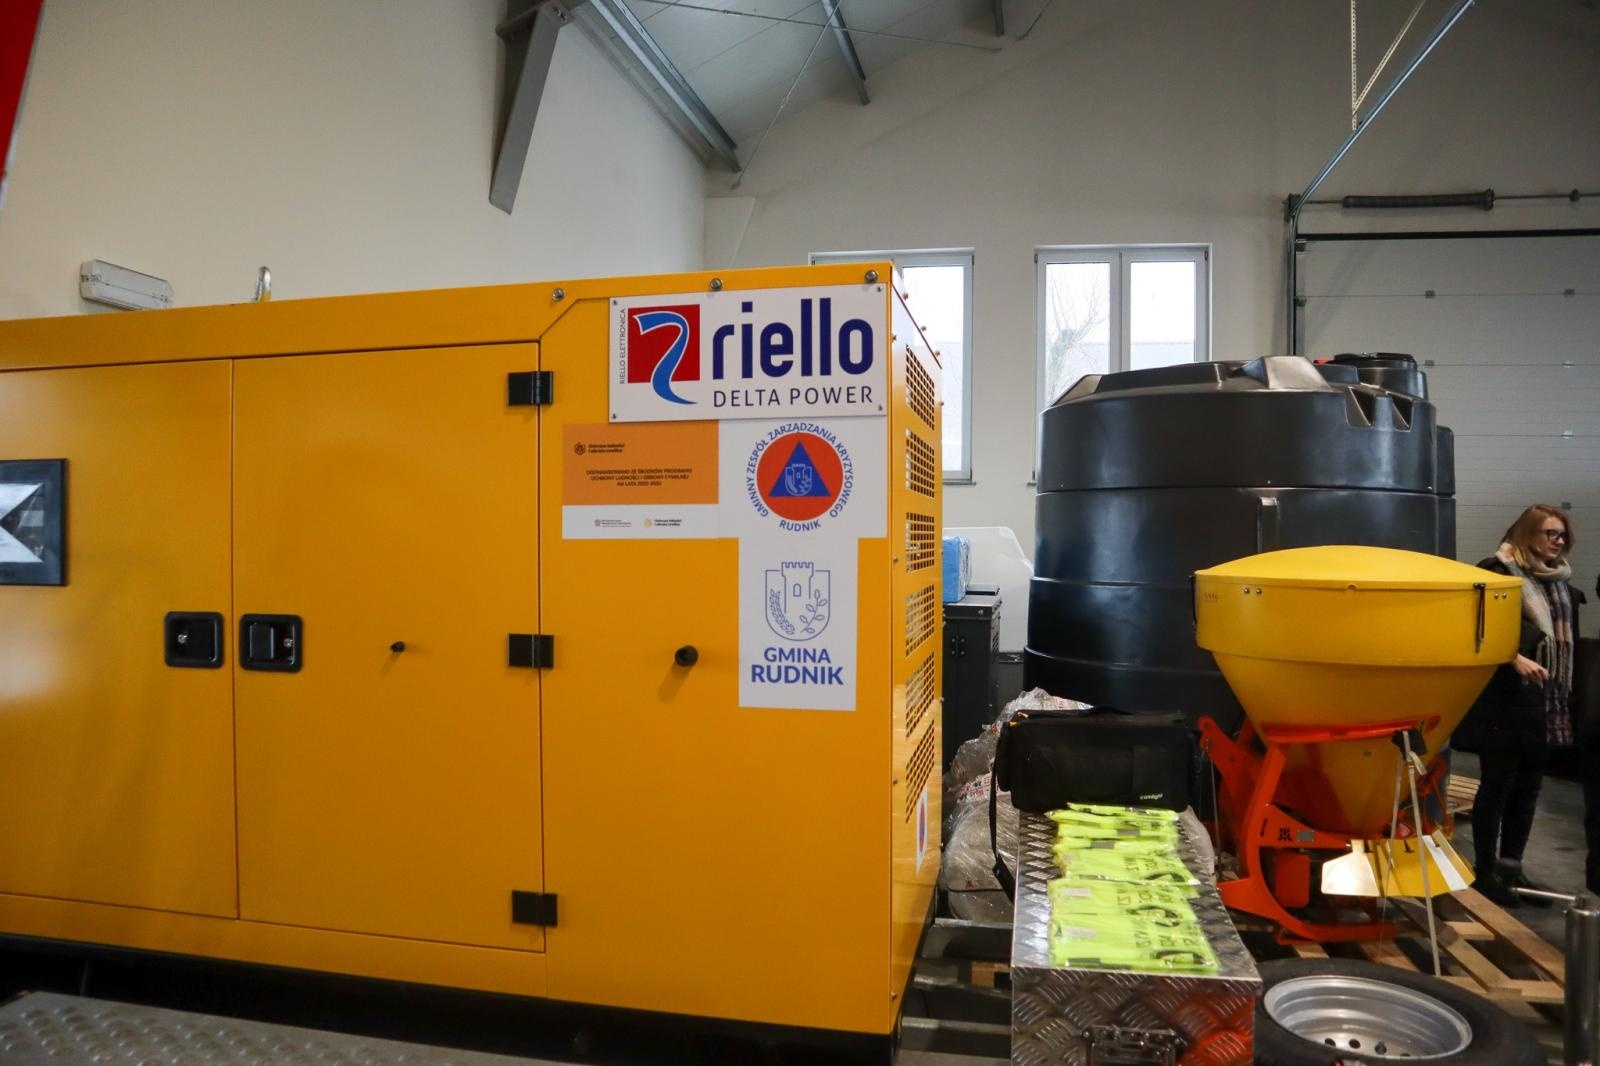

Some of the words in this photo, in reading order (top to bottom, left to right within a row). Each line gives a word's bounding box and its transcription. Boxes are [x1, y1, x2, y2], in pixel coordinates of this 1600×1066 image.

[712, 297, 874, 380] riello
[713, 389, 781, 408] DELTA
[790, 385, 873, 405] POWER
[767, 422, 837, 443] ZARZĄDZANIA
[747, 439, 769, 474] ZESPÓŁ
[829, 442, 854, 518] KRYZYSOWEGO
[746, 476, 769, 518] GMINNY
[779, 519, 822, 532] RUDNIK
[763, 647, 832, 664] GMINA
[751, 664, 844, 685] RUDNIK
